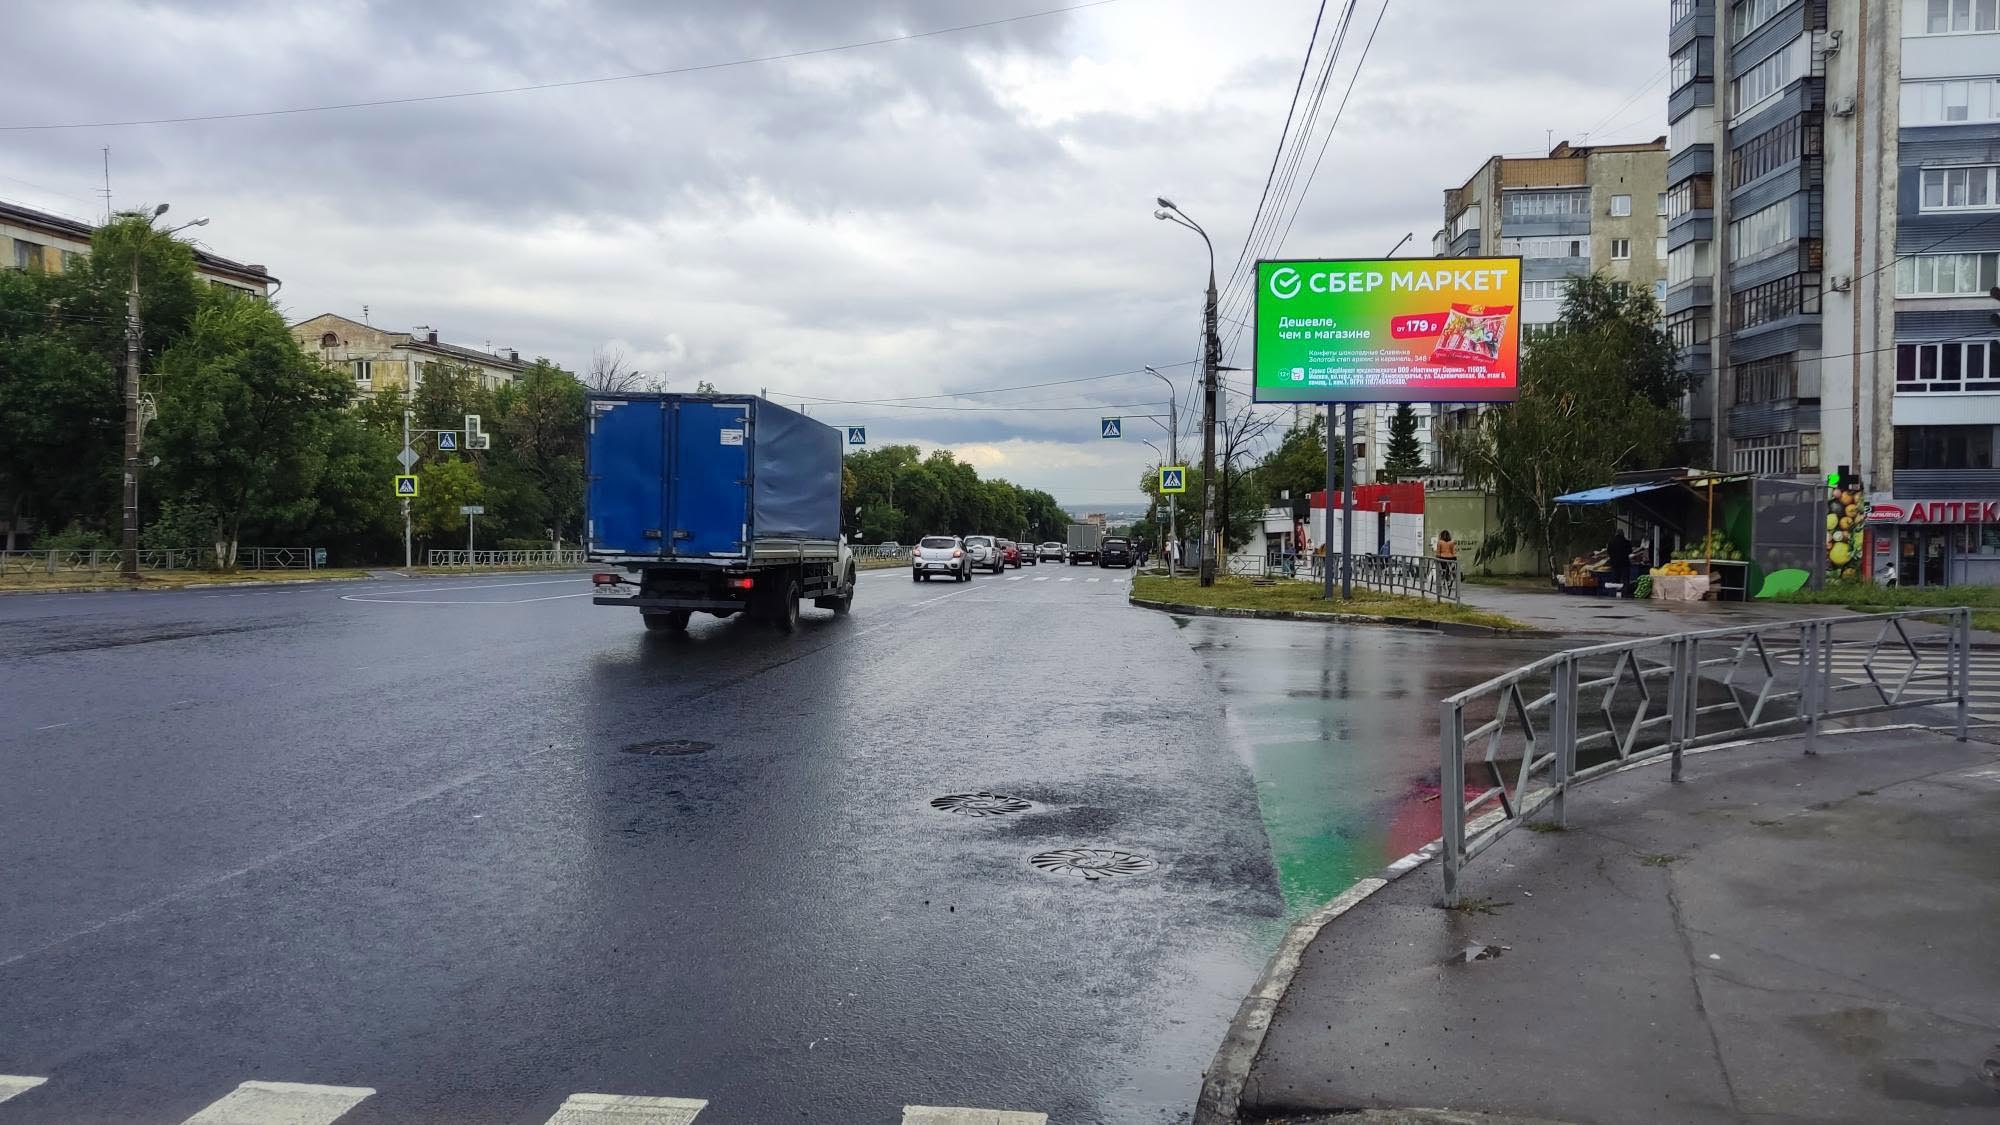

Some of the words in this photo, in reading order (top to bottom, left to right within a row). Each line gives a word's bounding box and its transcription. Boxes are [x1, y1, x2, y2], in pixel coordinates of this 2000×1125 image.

[1309, 272, 1383, 293] СБЕР
[1391, 270, 1508, 291] МАРКЕТ
[1279, 317, 1336, 329] Дешевле,
[1406, 320, 1429, 332] 179
[1279, 331, 1301, 339] чем
[1315, 330, 1370, 339] магазине
[1908, 502, 2000, 522] АПТЕК
